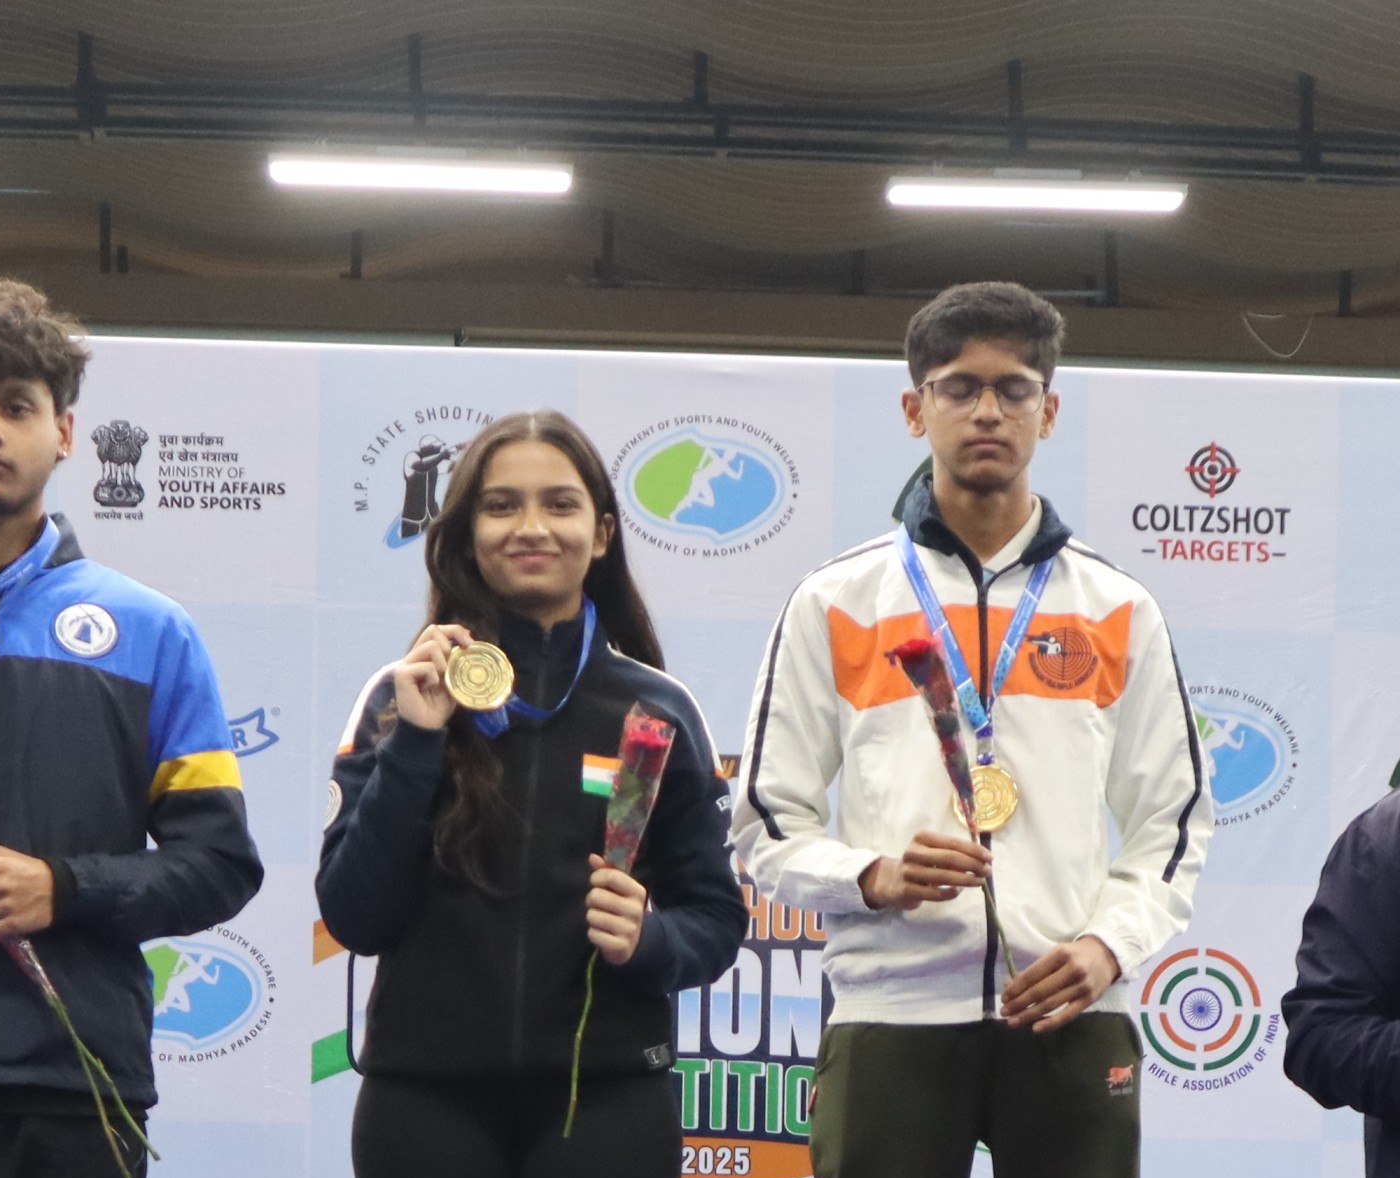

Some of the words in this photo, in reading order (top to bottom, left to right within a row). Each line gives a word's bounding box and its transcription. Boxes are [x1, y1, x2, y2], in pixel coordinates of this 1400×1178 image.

[159, 435, 178, 446] युवा
[182, 432, 224, 446] कार्यक्रम
[159, 452, 173, 462] एवं
[178, 449, 198, 462] खेल
[362, 420, 406, 465] STATE
[610, 426, 655, 480] DEPARTMENT
[658, 420, 670, 430] OF
[674, 415, 713, 426] SPORTS
[716, 416, 738, 428] AND
[742, 422, 774, 444] YOUTH
[774, 442, 800, 485] WELFARE
[159, 466, 223, 478] MINISTRY
[228, 467, 245, 478] OF
[159, 480, 214, 493] YOUTH
[220, 482, 285, 495] AFFAIRS
[158, 496, 194, 508] AND
[200, 497, 261, 510] SPORTS
[1132, 503, 1291, 535] COLTZSHOT
[683, 547, 697, 556] OF
[703, 542, 751, 557] MADHYA
[754, 506, 794, 546] PRADESH
[1158, 539, 1271, 563] TARGETS
[1218, 688, 1239, 697] AND
[1242, 693, 1276, 714] YOUTH
[1274, 712, 1299, 755] WELFARE
[1254, 776, 1294, 815] PRADESH
[217, 926, 249, 948] YOUTH
[250, 946, 276, 989] WELFARE
[159, 1053, 173, 1062] OF
[178, 1048, 228, 1063] MADHYA
[231, 1010, 272, 1051] PRADESH
[1149, 1062, 1178, 1086] RIFLE
[1183, 1062, 1254, 1090] ASSOCIATION
[1254, 1047, 1267, 1062] OF
[1265, 1013, 1280, 1044] INDIA
[682, 1146, 750, 1175] 2025
